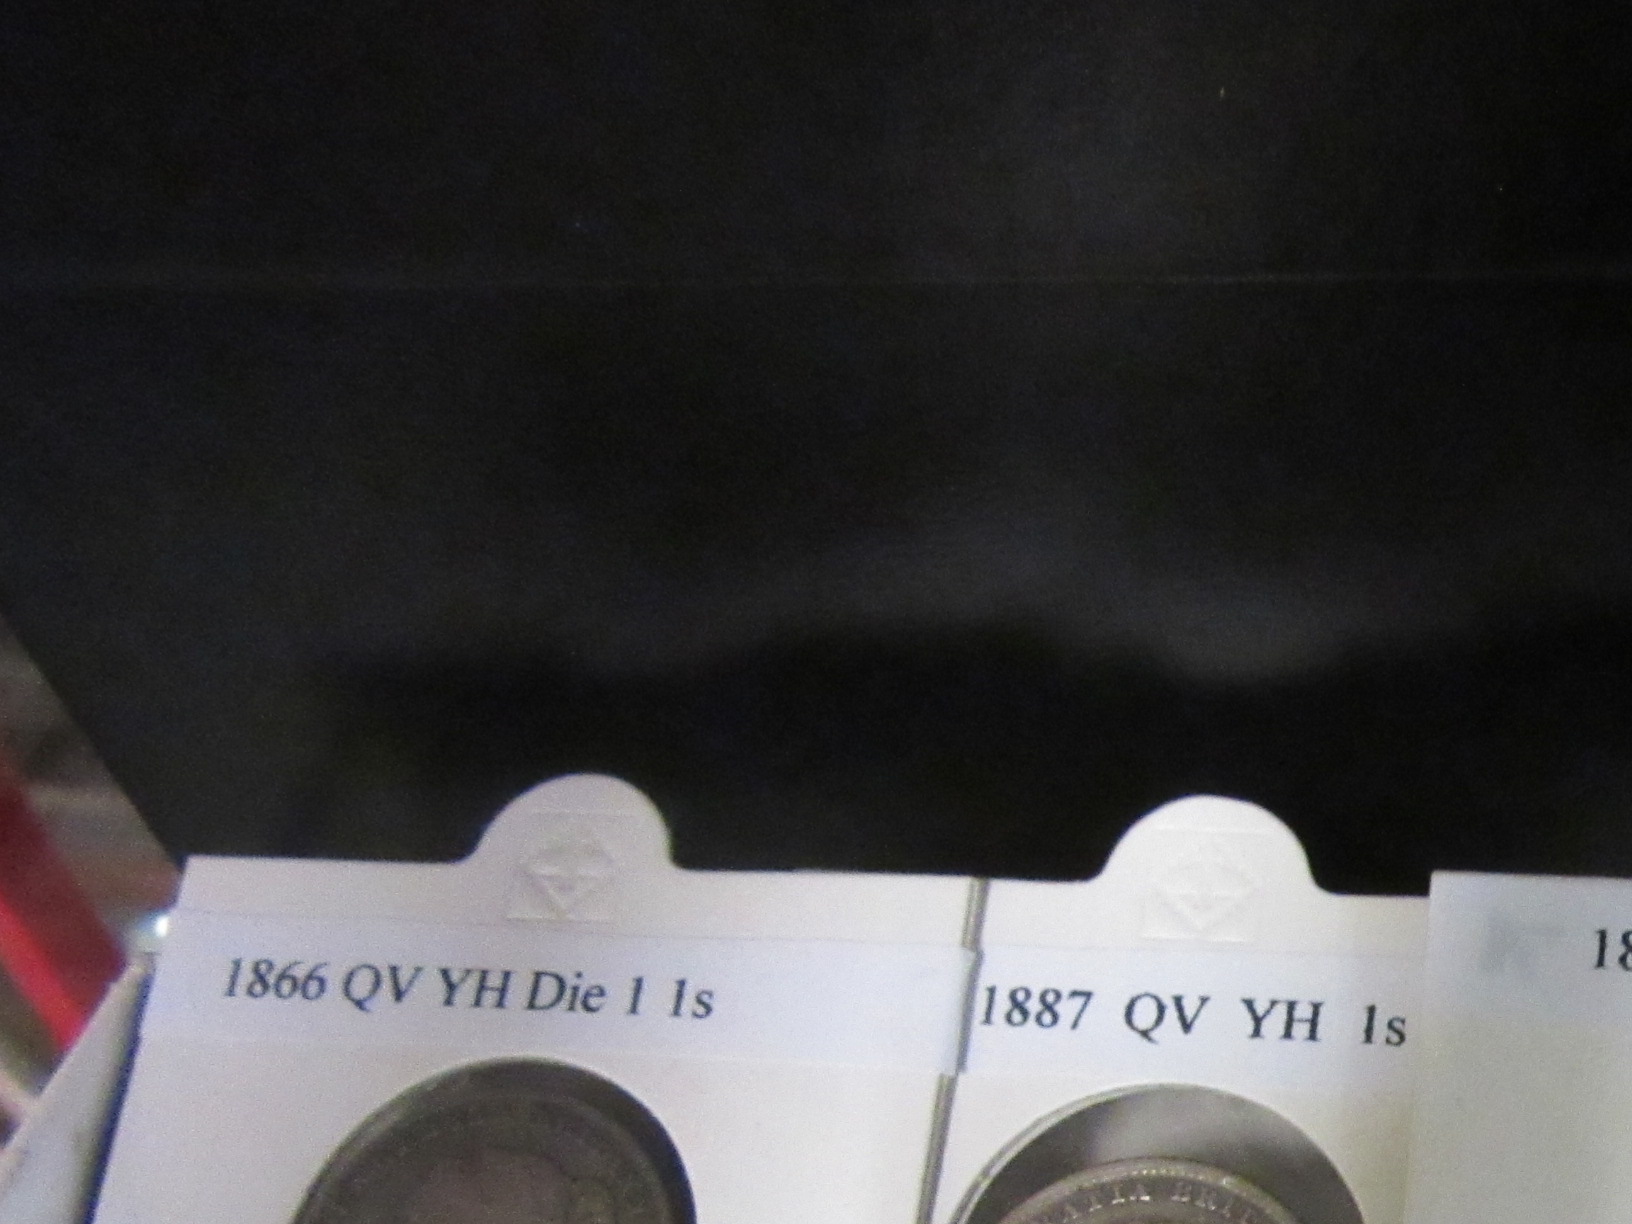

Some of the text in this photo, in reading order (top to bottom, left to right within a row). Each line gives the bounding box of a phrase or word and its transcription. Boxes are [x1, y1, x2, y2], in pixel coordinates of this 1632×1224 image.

[222, 956, 716, 1020] 1866 QV YH Die 1 1s
[979, 983, 1408, 1047] 1887 QV YH 1s
